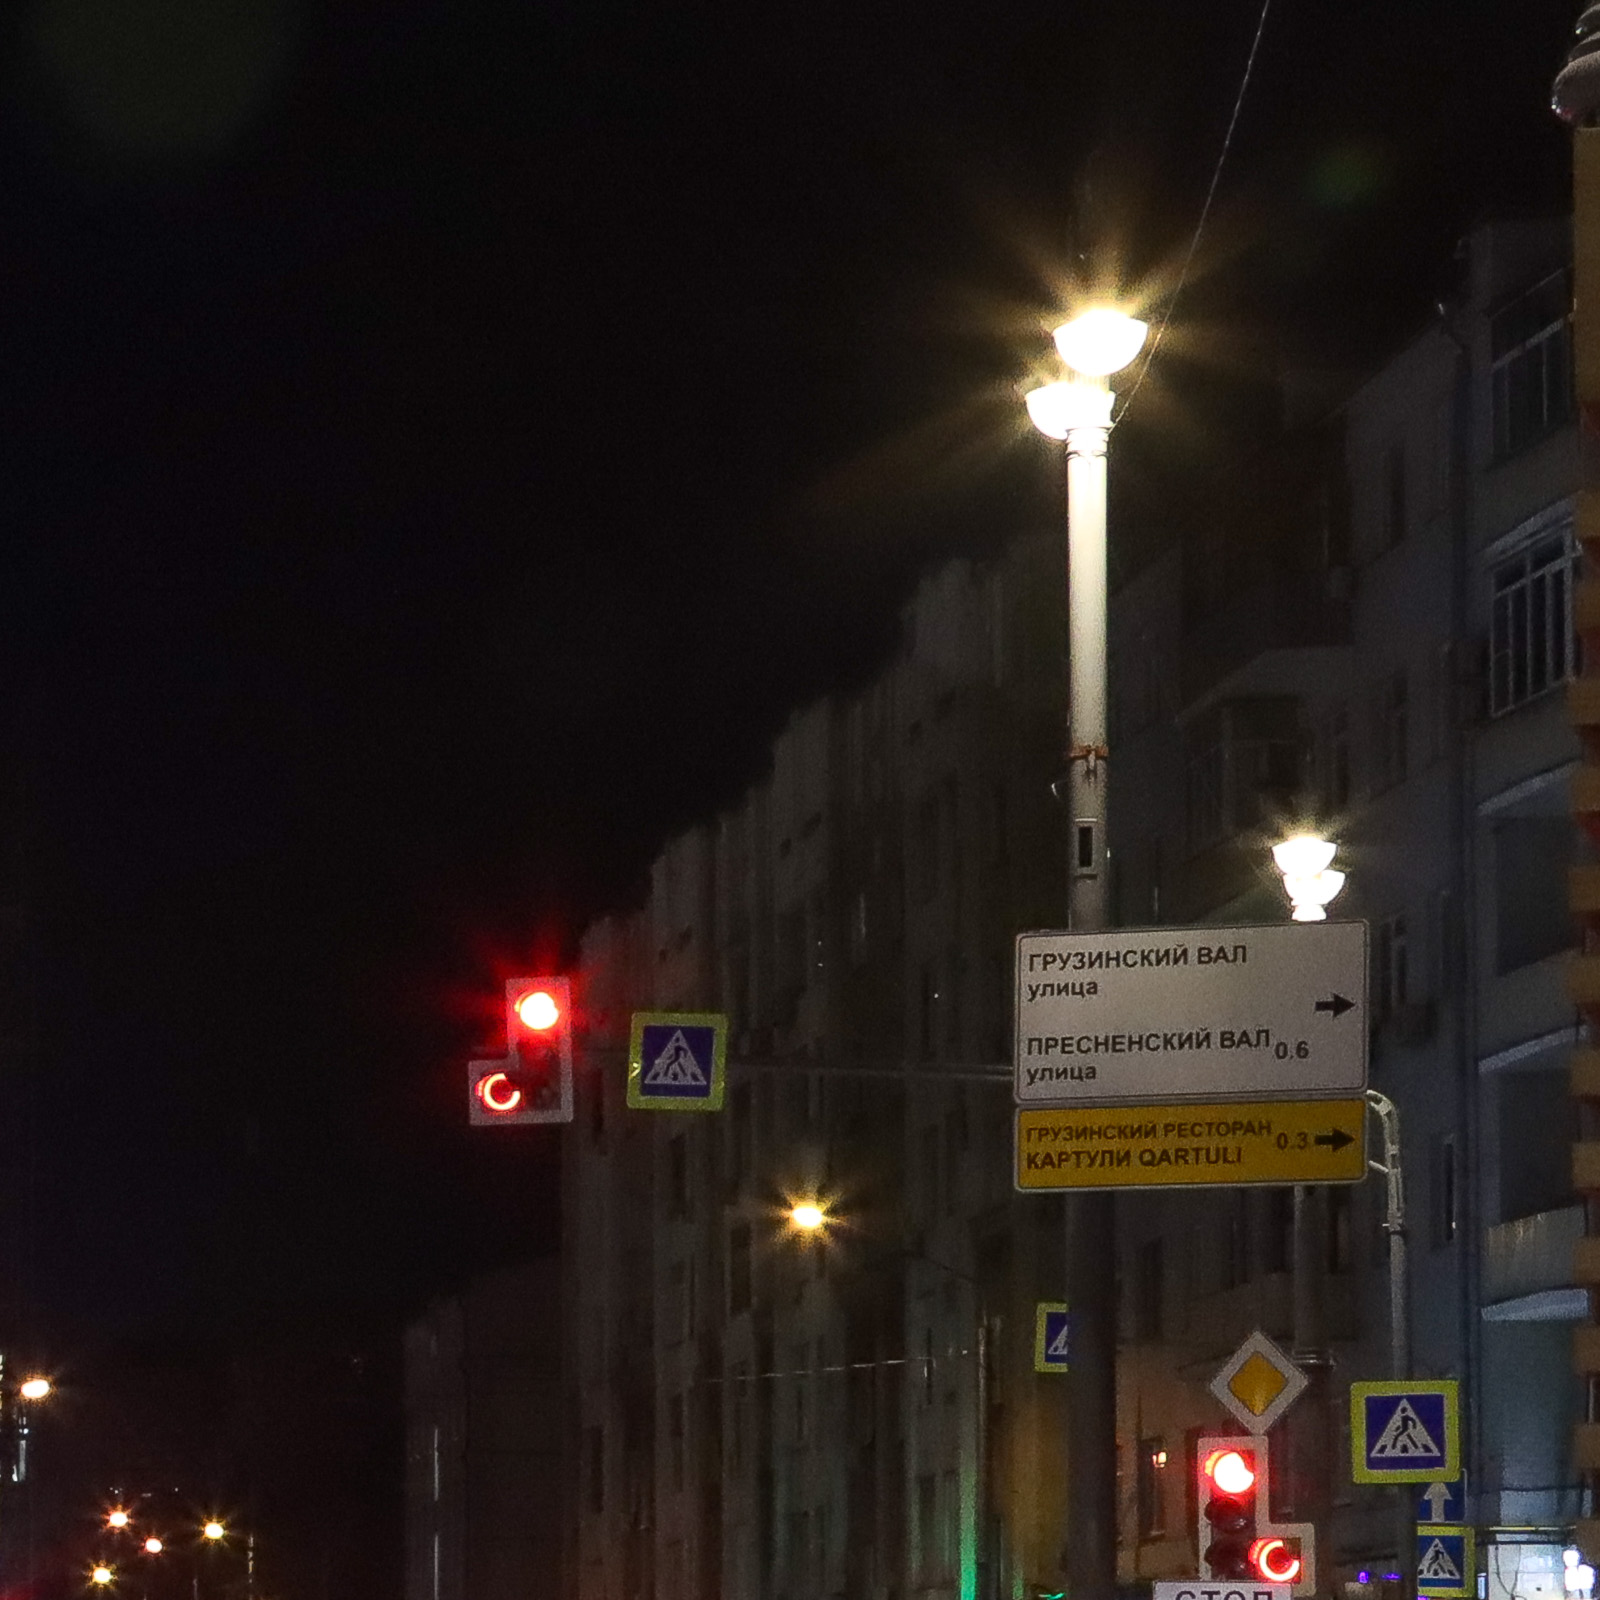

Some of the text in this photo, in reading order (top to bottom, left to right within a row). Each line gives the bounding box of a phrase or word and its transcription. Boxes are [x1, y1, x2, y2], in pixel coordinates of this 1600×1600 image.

[1028, 943, 1249, 972] ГРУЗИНСКИЙ ВАЛ
[1027, 980, 1099, 1002] улица
[1027, 1027, 1271, 1056] ПРЕСНЕНСКИЙ ВАЛ
[1026, 1063, 1098, 1086] улица
[1026, 1120, 1272, 1143] ГРУЗИНСКИЙ РЕСТОРАН
[1026, 1146, 1243, 1171] КАРТУЛИ QARTULI
